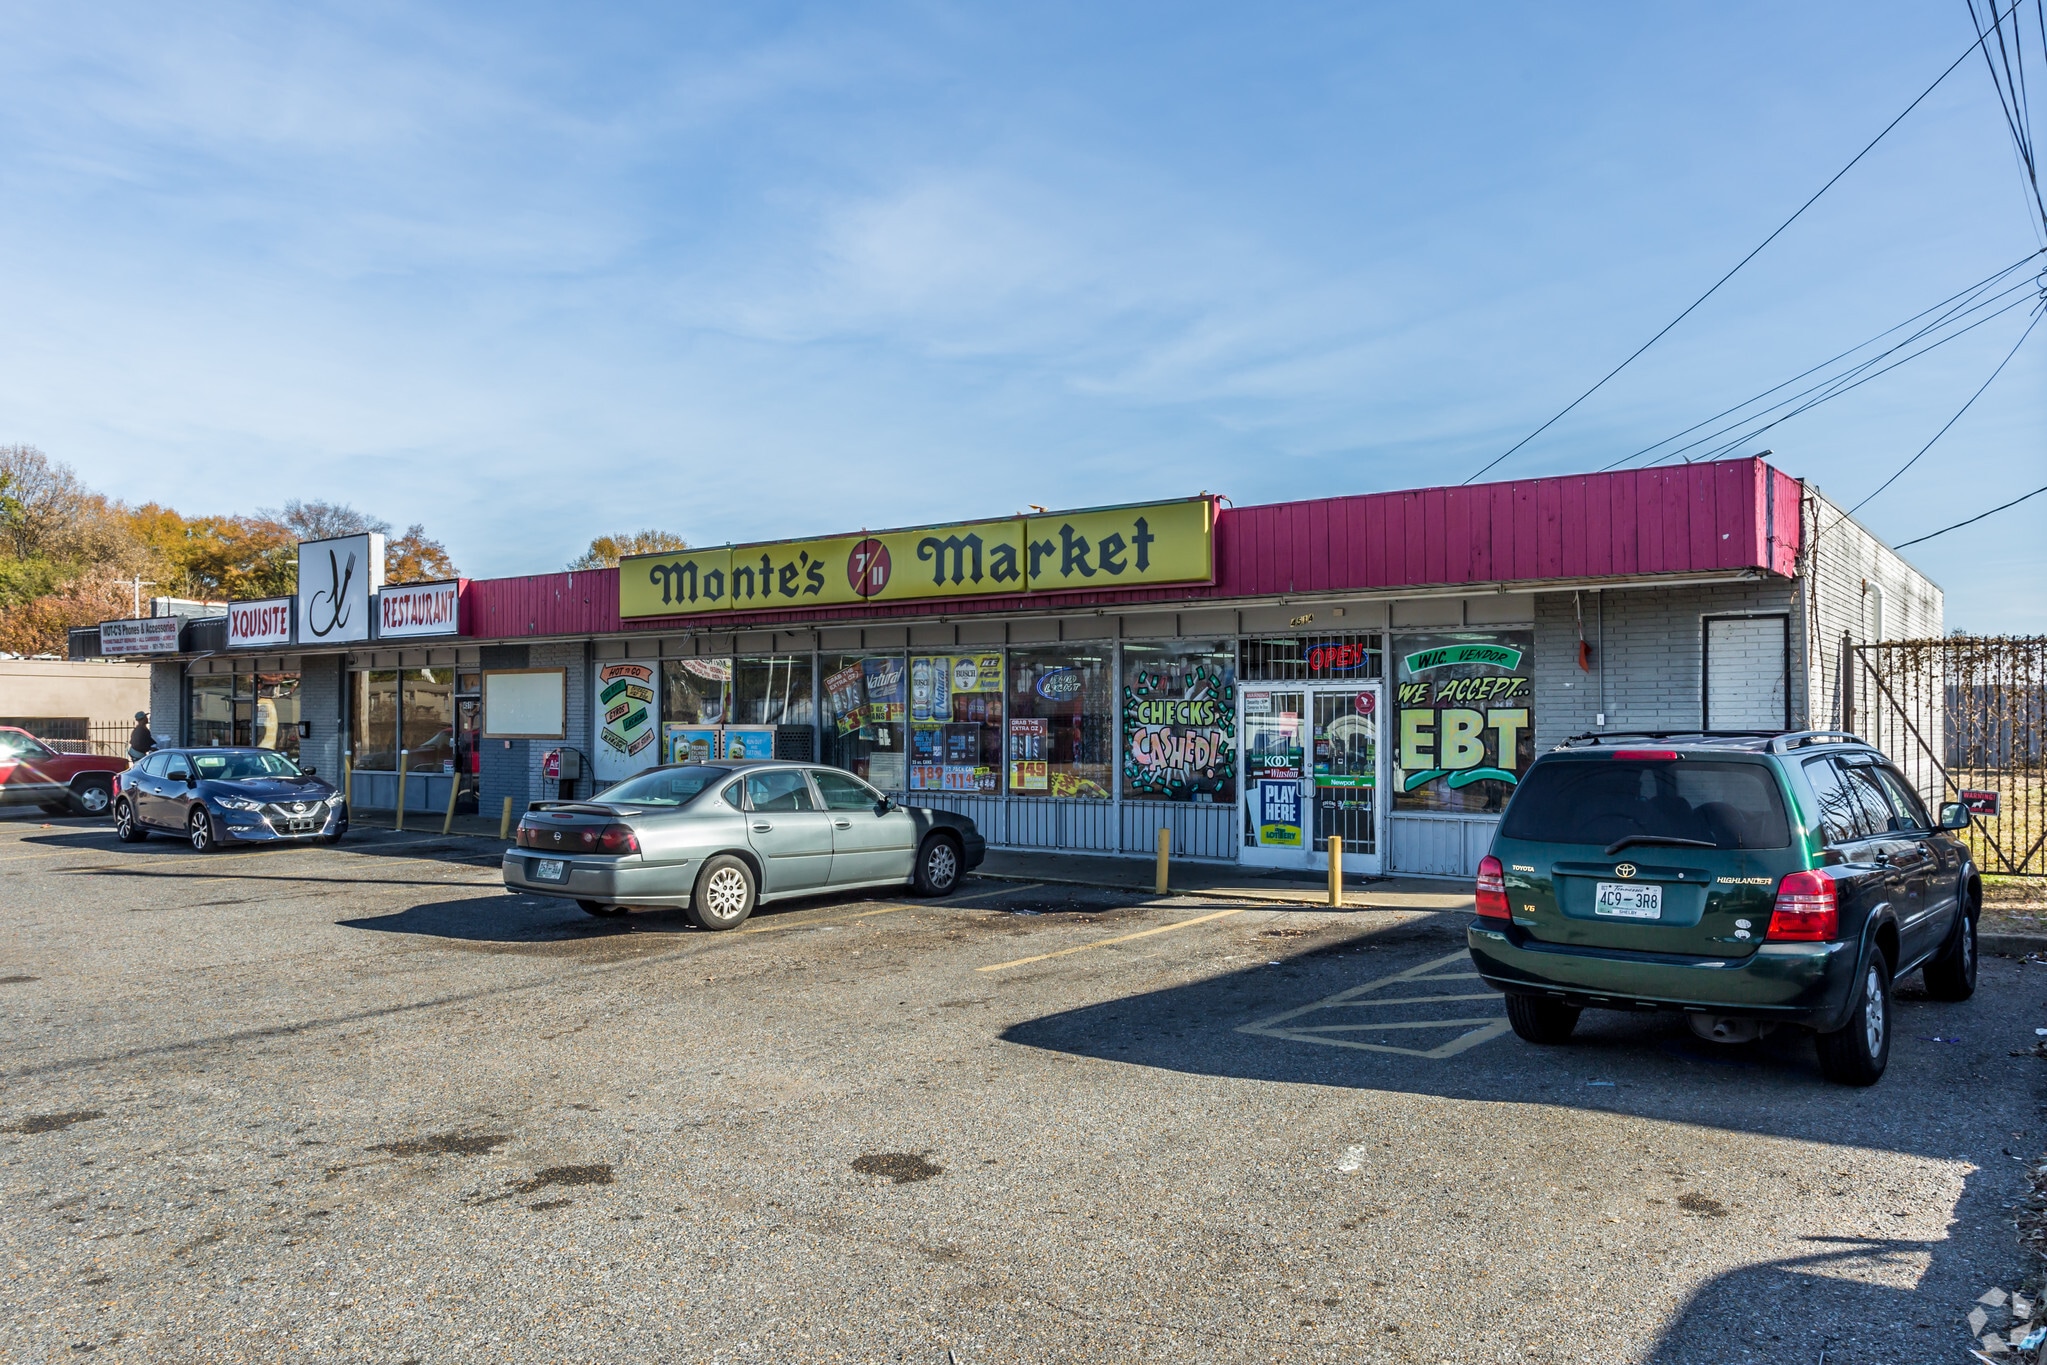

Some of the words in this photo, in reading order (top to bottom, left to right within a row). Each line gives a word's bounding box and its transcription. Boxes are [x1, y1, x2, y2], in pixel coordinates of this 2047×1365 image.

[650, 550, 825, 606] Monte's
[917, 517, 1154, 587] Market
[383, 590, 455, 629] RESTAURANT
[122, 624, 139, 635] Phones
[141, 623, 144, 634] &
[146, 621, 175, 634] Accessories
[231, 606, 288, 639] XQUISITE
[1310, 643, 1363, 670] OPEN
[1418, 651, 1447, 668] W.I.C.
[1459, 649, 1508, 663] VENDOR
[609, 668, 624, 677] HOT
[631, 667, 641, 676] GO
[826, 674, 842, 686] GRAB
[843, 668, 854, 676] THE
[866, 666, 903, 690] Natural
[956, 669, 976, 678] BUSCH
[829, 679, 847, 691] EXTRA
[935, 668, 945, 710] Natural
[1398, 682, 1432, 704] WE
[609, 706, 625, 720] GYROS
[871, 712, 885, 720] ANS
[1137, 700, 1215, 726] CHECKS
[1399, 706, 1529, 771] EBT
[1132, 727, 1220, 779] CASHED!
[1264, 755, 1292, 767] KOOL
[550, 759, 559, 768] Air
[1270, 767, 1299, 778] Winston
[913, 766, 943, 788] $189
[1011, 762, 1046, 787] $149
[1331, 779, 1356, 787] Newport
[1265, 785, 1296, 804] PLAY
[1963, 792, 1995, 800] WARNING!
[1265, 803, 1296, 822] HERE
[1512, 864, 1535, 872] TOYOTA
[1717, 876, 1772, 885] HIGHLANDER
[1524, 904, 1535, 912] V6
